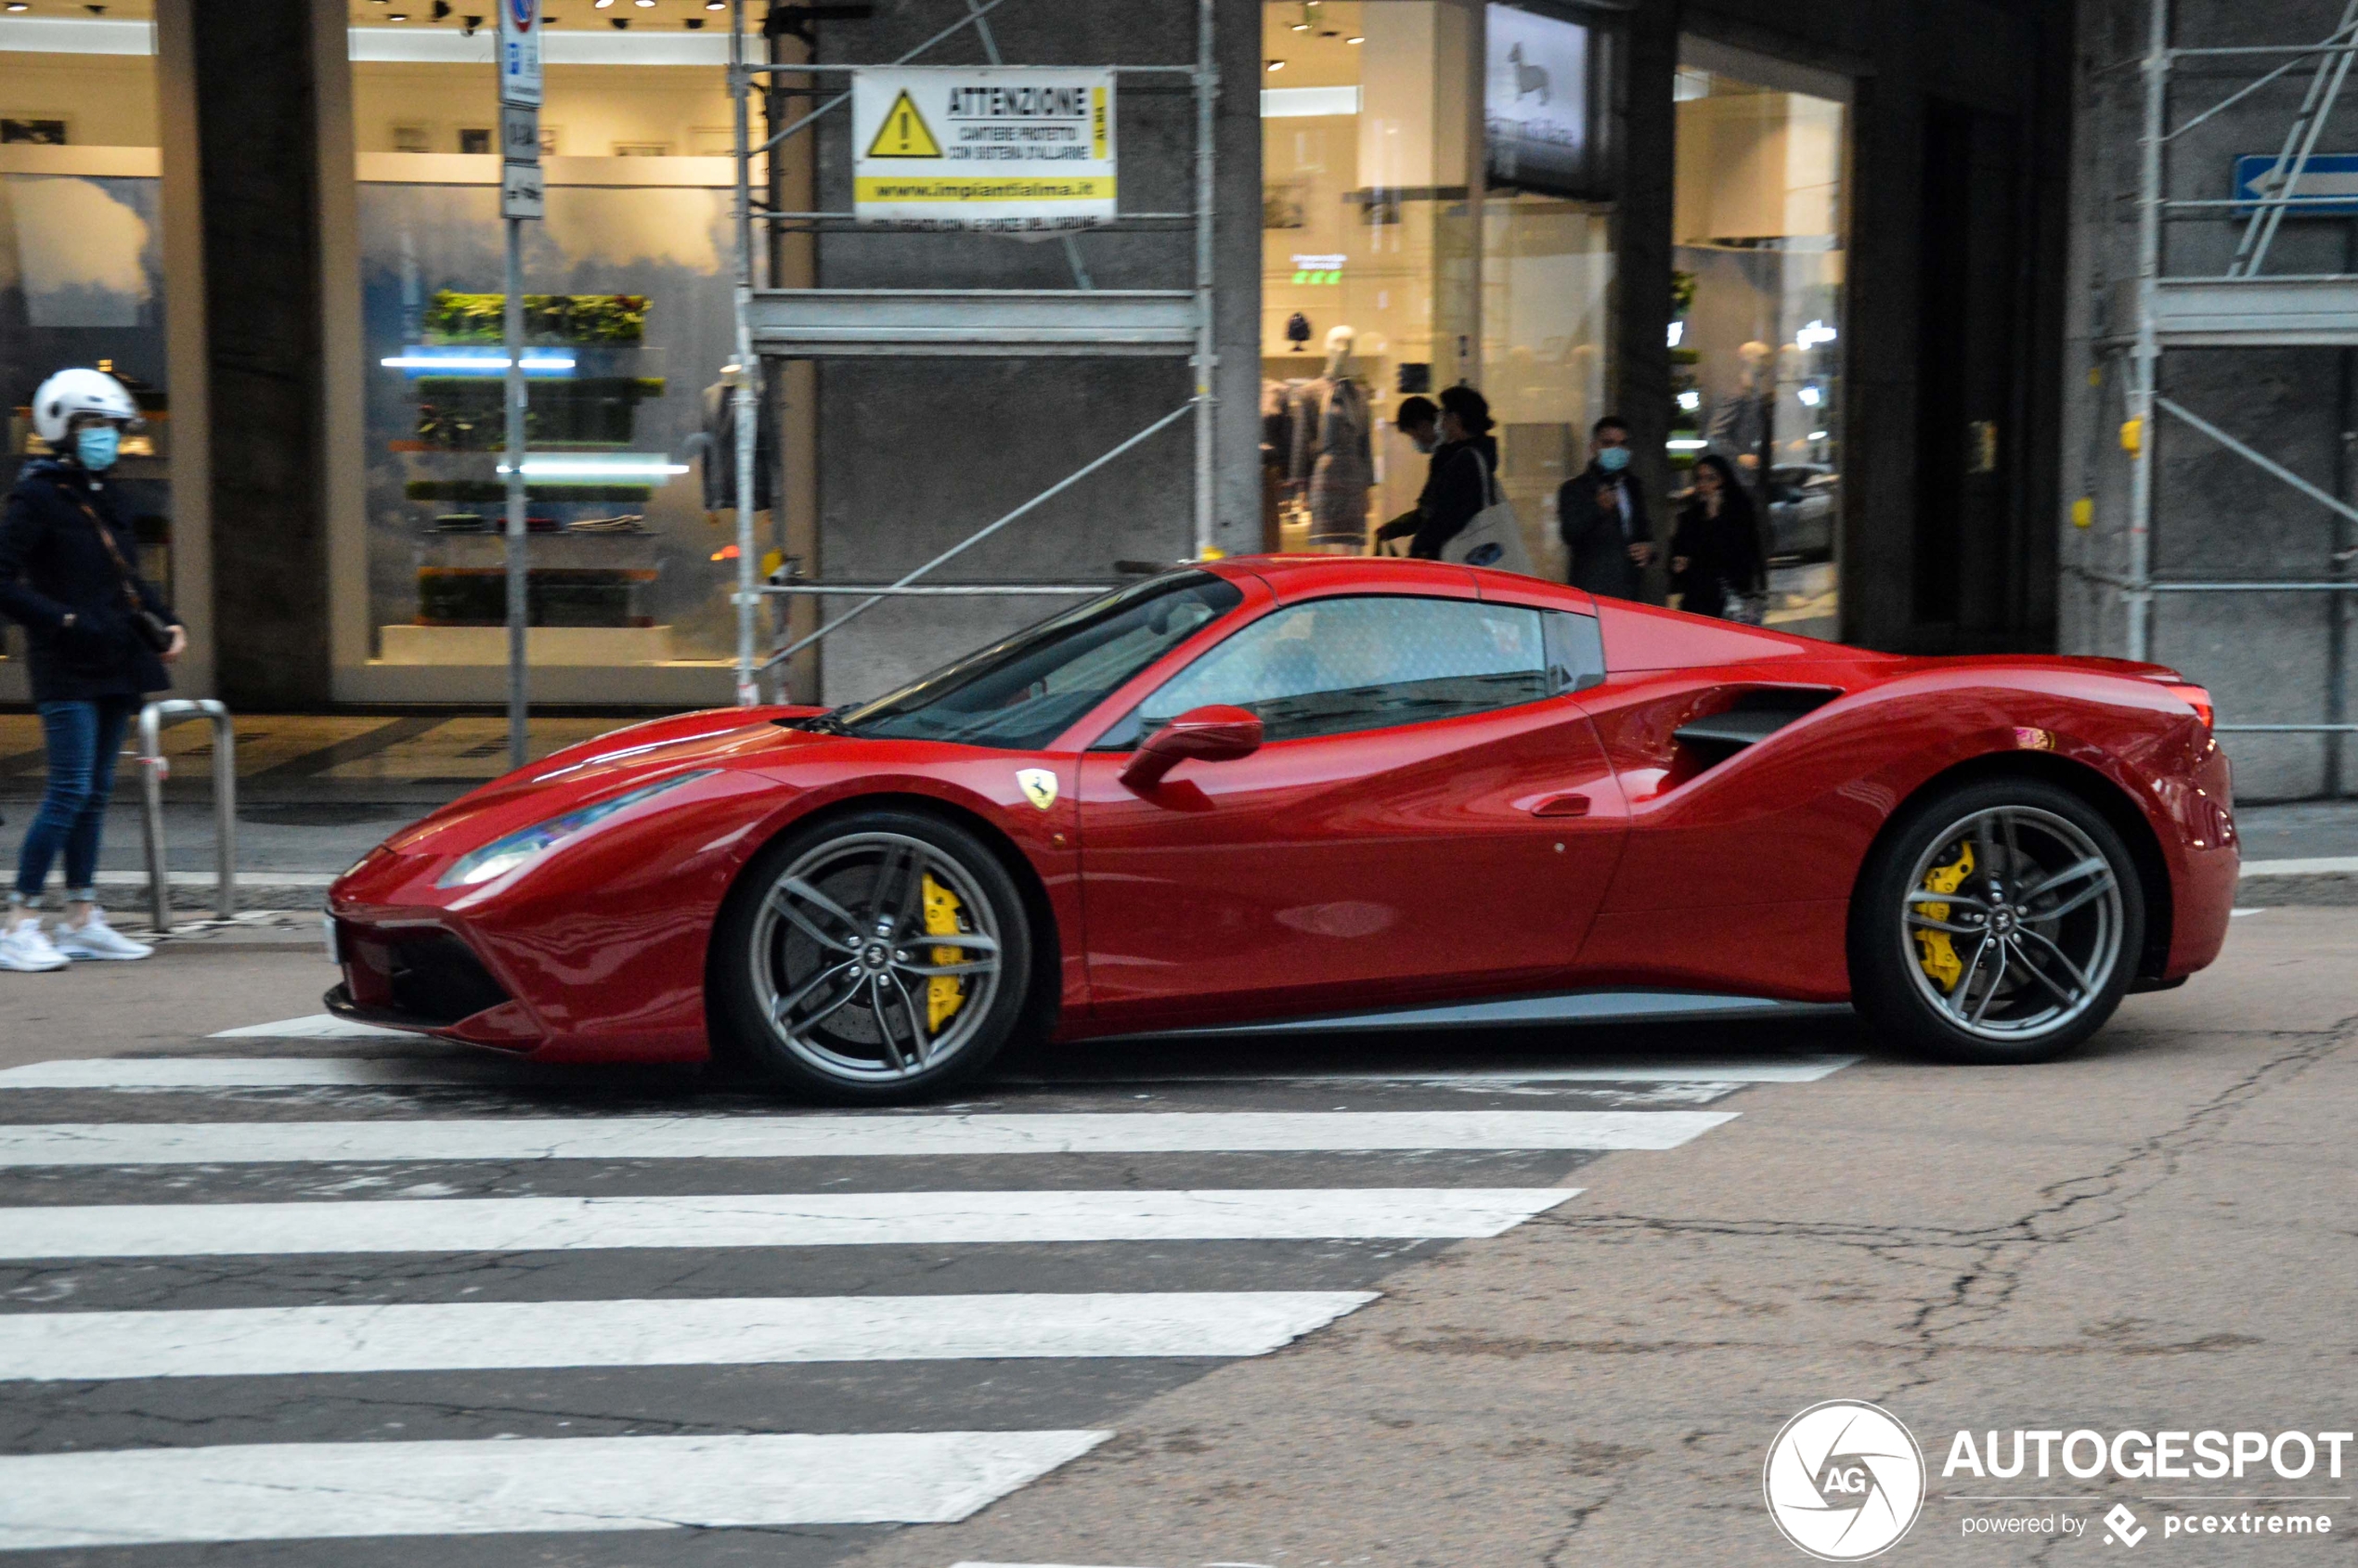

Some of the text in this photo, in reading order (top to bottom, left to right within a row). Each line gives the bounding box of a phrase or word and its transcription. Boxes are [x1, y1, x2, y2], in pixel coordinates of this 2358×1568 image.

[947, 86, 1087, 116] ATTENZIONE
[959, 125, 1079, 141] CANTIERE PROTETTO
[948, 146, 972, 161] CON
[974, 146, 1023, 161] SISTEMA
[874, 180, 1095, 201] www.impiantialma.it
